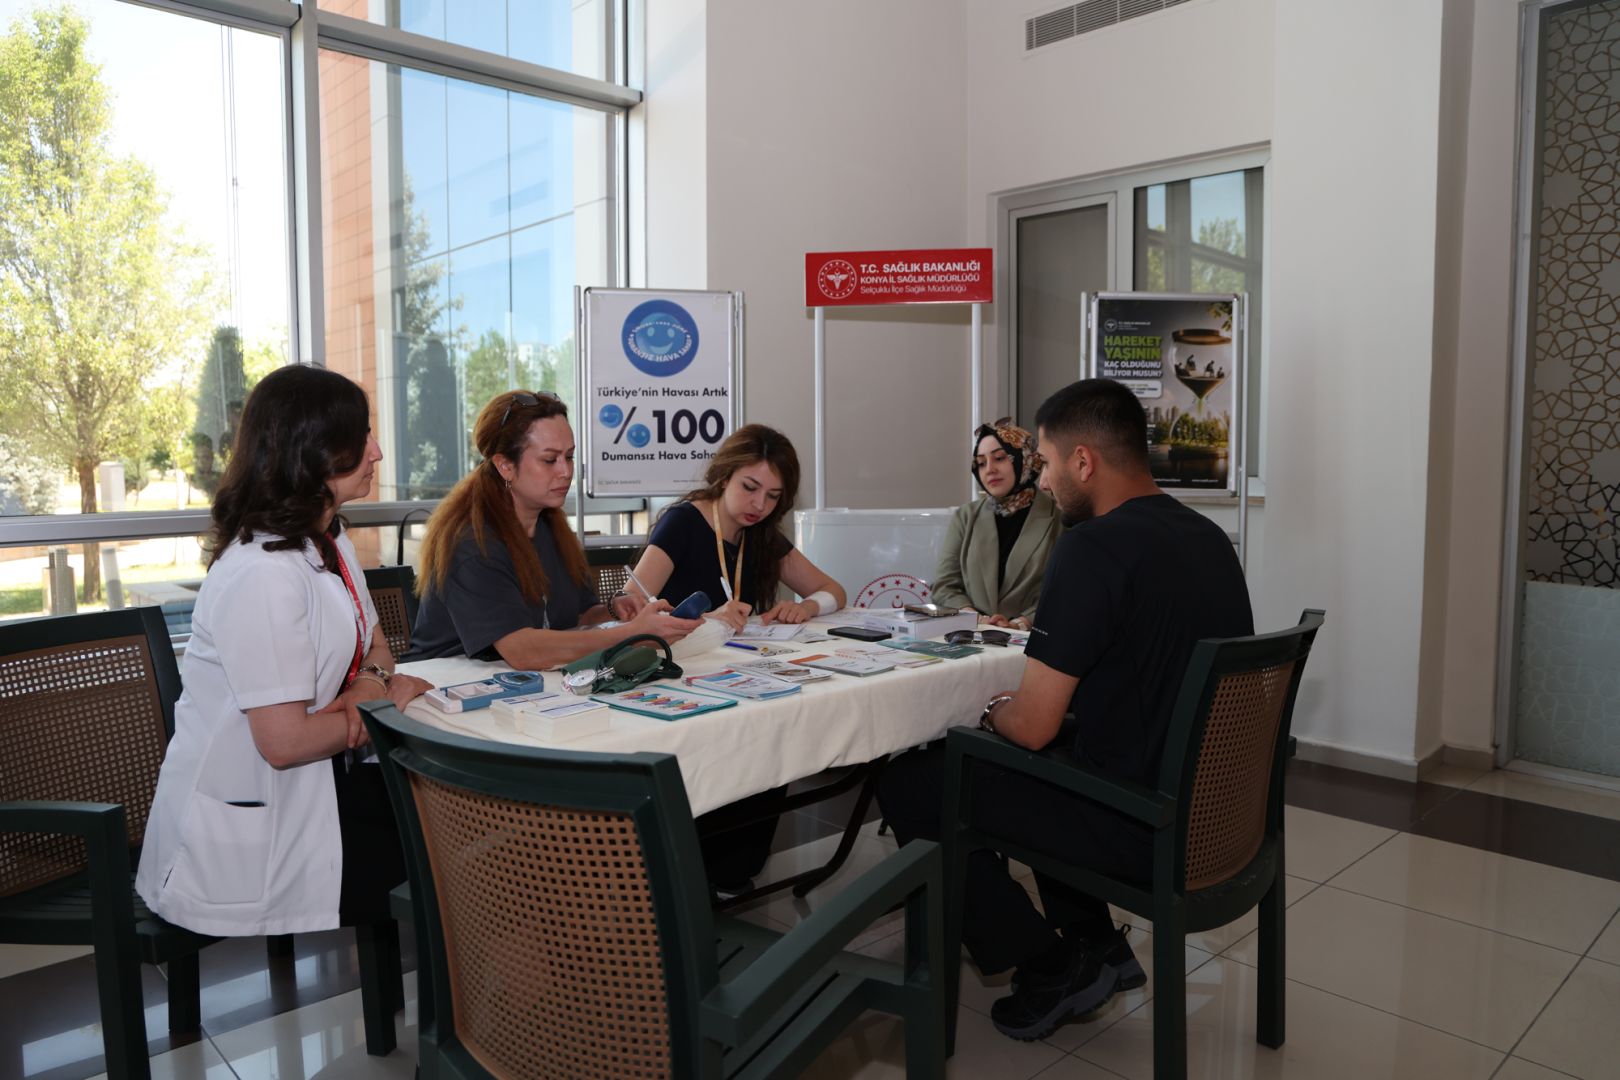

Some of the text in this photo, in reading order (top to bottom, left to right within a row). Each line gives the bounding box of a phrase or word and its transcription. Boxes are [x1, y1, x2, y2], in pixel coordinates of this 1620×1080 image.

[860, 260, 981, 273] T.C. SAĞLIK BAKANLIĞI
[860, 273, 980, 284] KONYA İL SAĞLIK MÜDÜRLÜĞÜ
[905, 285, 926, 294] Sağlık
[927, 284, 967, 293] Müdürlüğü
[1104, 335, 1162, 346] HAREKET
[655, 352, 680, 362] HAVA
[1104, 360, 1162, 369] KAÇ OLDUĞUNU
[1132, 369, 1162, 377] MUSUN?
[662, 387, 699, 397] Havası
[702, 387, 728, 397] Artık
[601, 451, 655, 461] Dumansız
[658, 451, 687, 460] Hava
